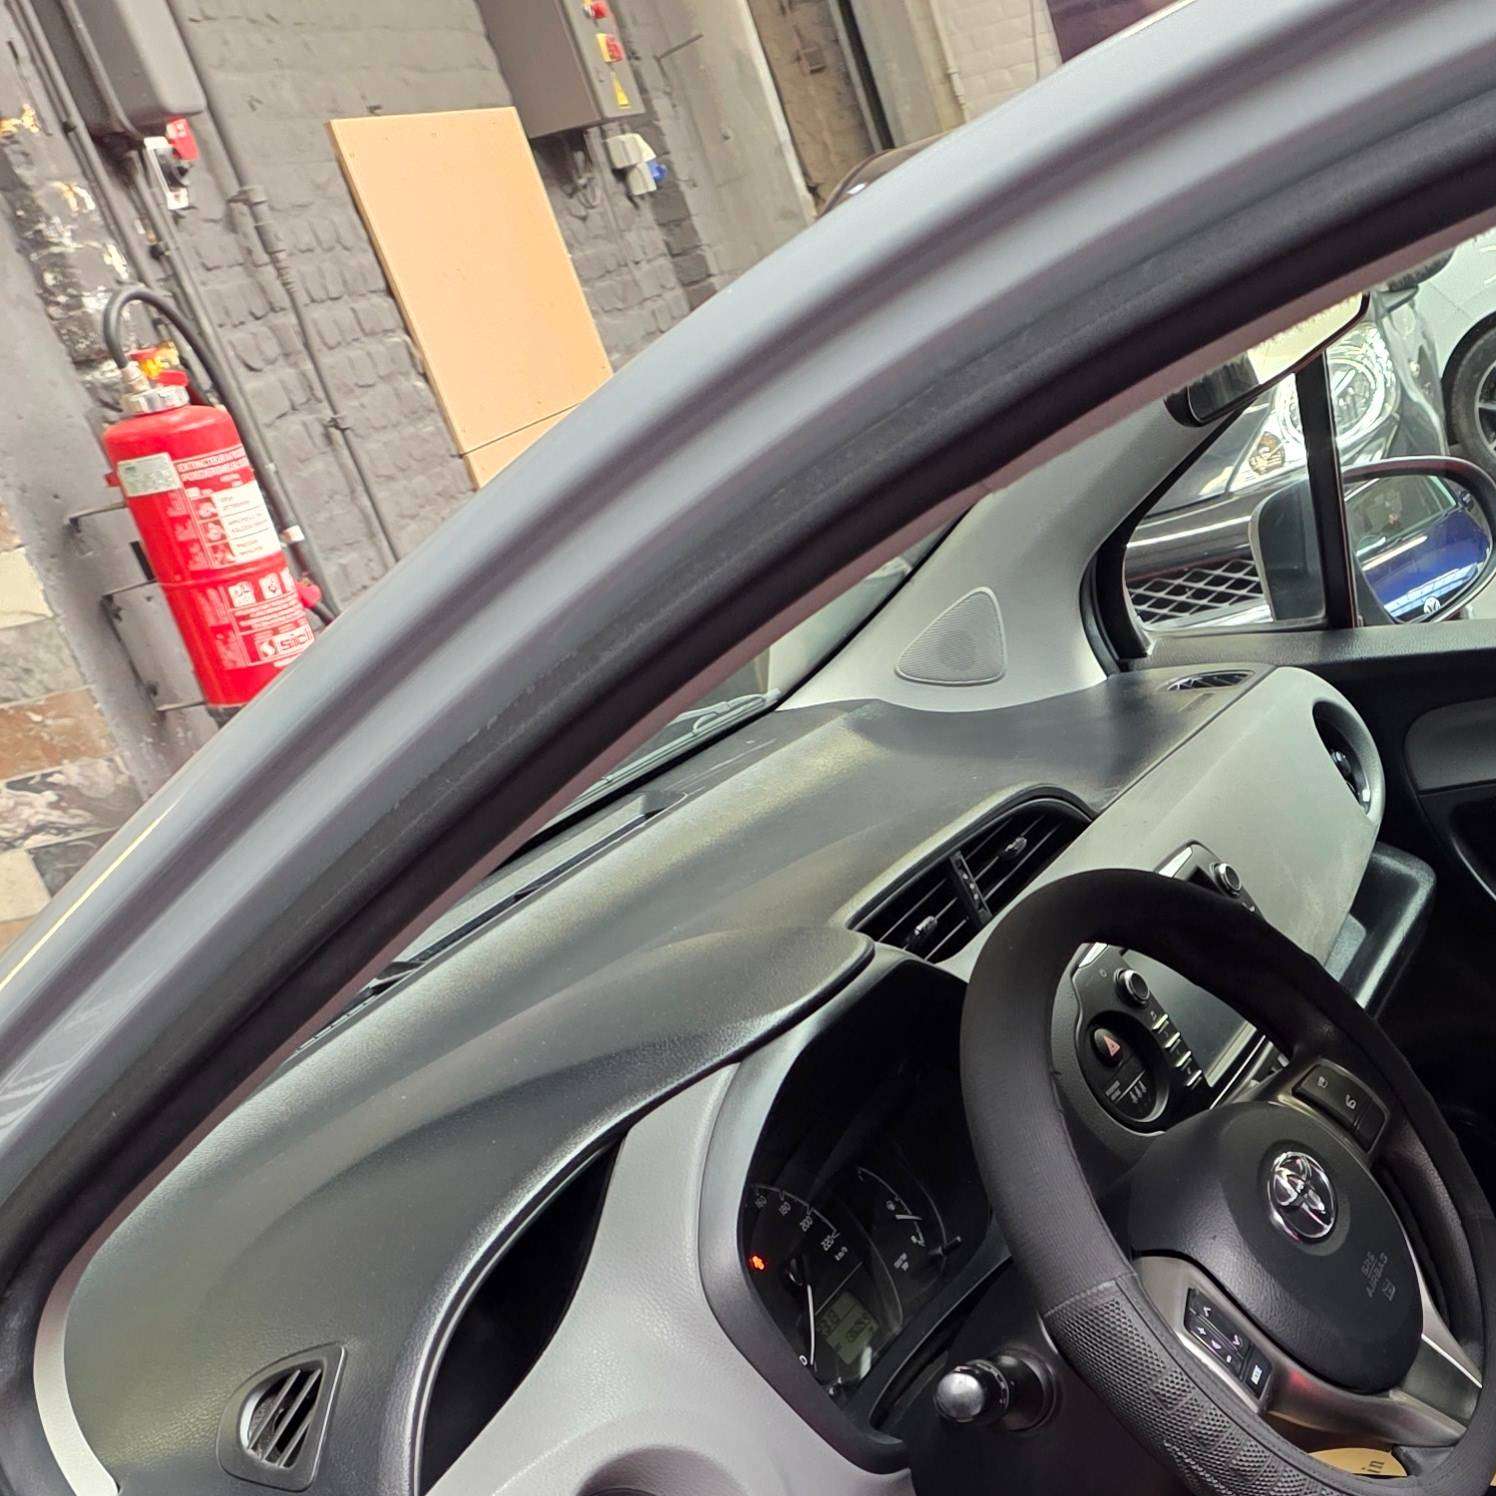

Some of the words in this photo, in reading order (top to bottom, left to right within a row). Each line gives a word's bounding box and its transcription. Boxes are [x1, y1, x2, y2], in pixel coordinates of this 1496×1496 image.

[800, 1215, 814, 1232] 200
[821, 1237, 836, 1251] 220
[799, 1355, 808, 1366] 0
